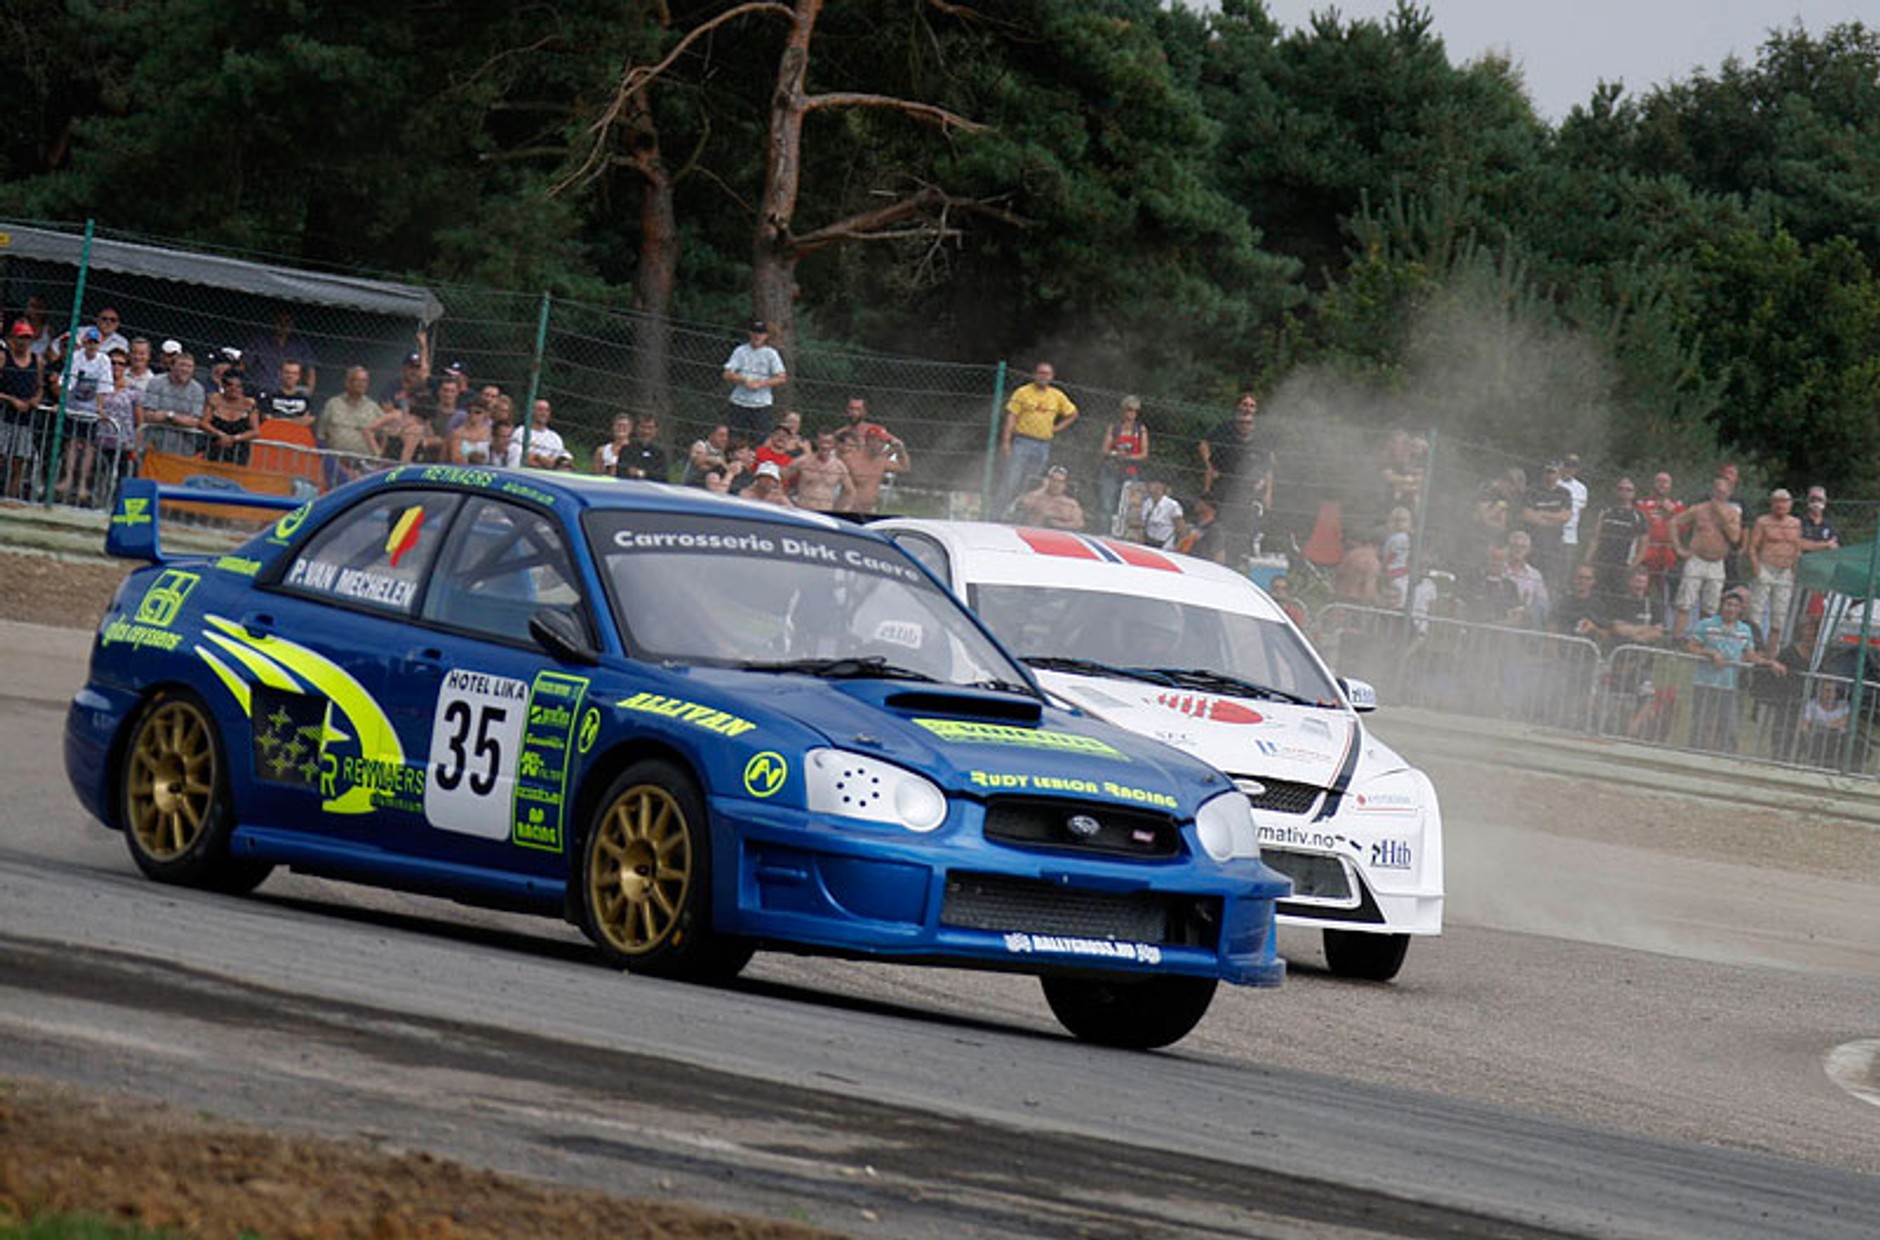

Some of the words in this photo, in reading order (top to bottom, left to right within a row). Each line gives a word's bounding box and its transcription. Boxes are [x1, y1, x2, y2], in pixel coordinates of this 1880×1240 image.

[614, 529, 774, 552] Carrosserie
[782, 538, 837, 561] Dirk
[335, 567, 417, 608] MECHELEN
[449, 670, 490, 696] HOTEL
[493, 680, 526, 701] LIKA
[616, 691, 757, 737] ALLIVAN
[434, 700, 507, 796] 35
[343, 756, 425, 794] REYNAERS
[970, 770, 1028, 787] RUDY
[1103, 782, 1178, 808] RACING
